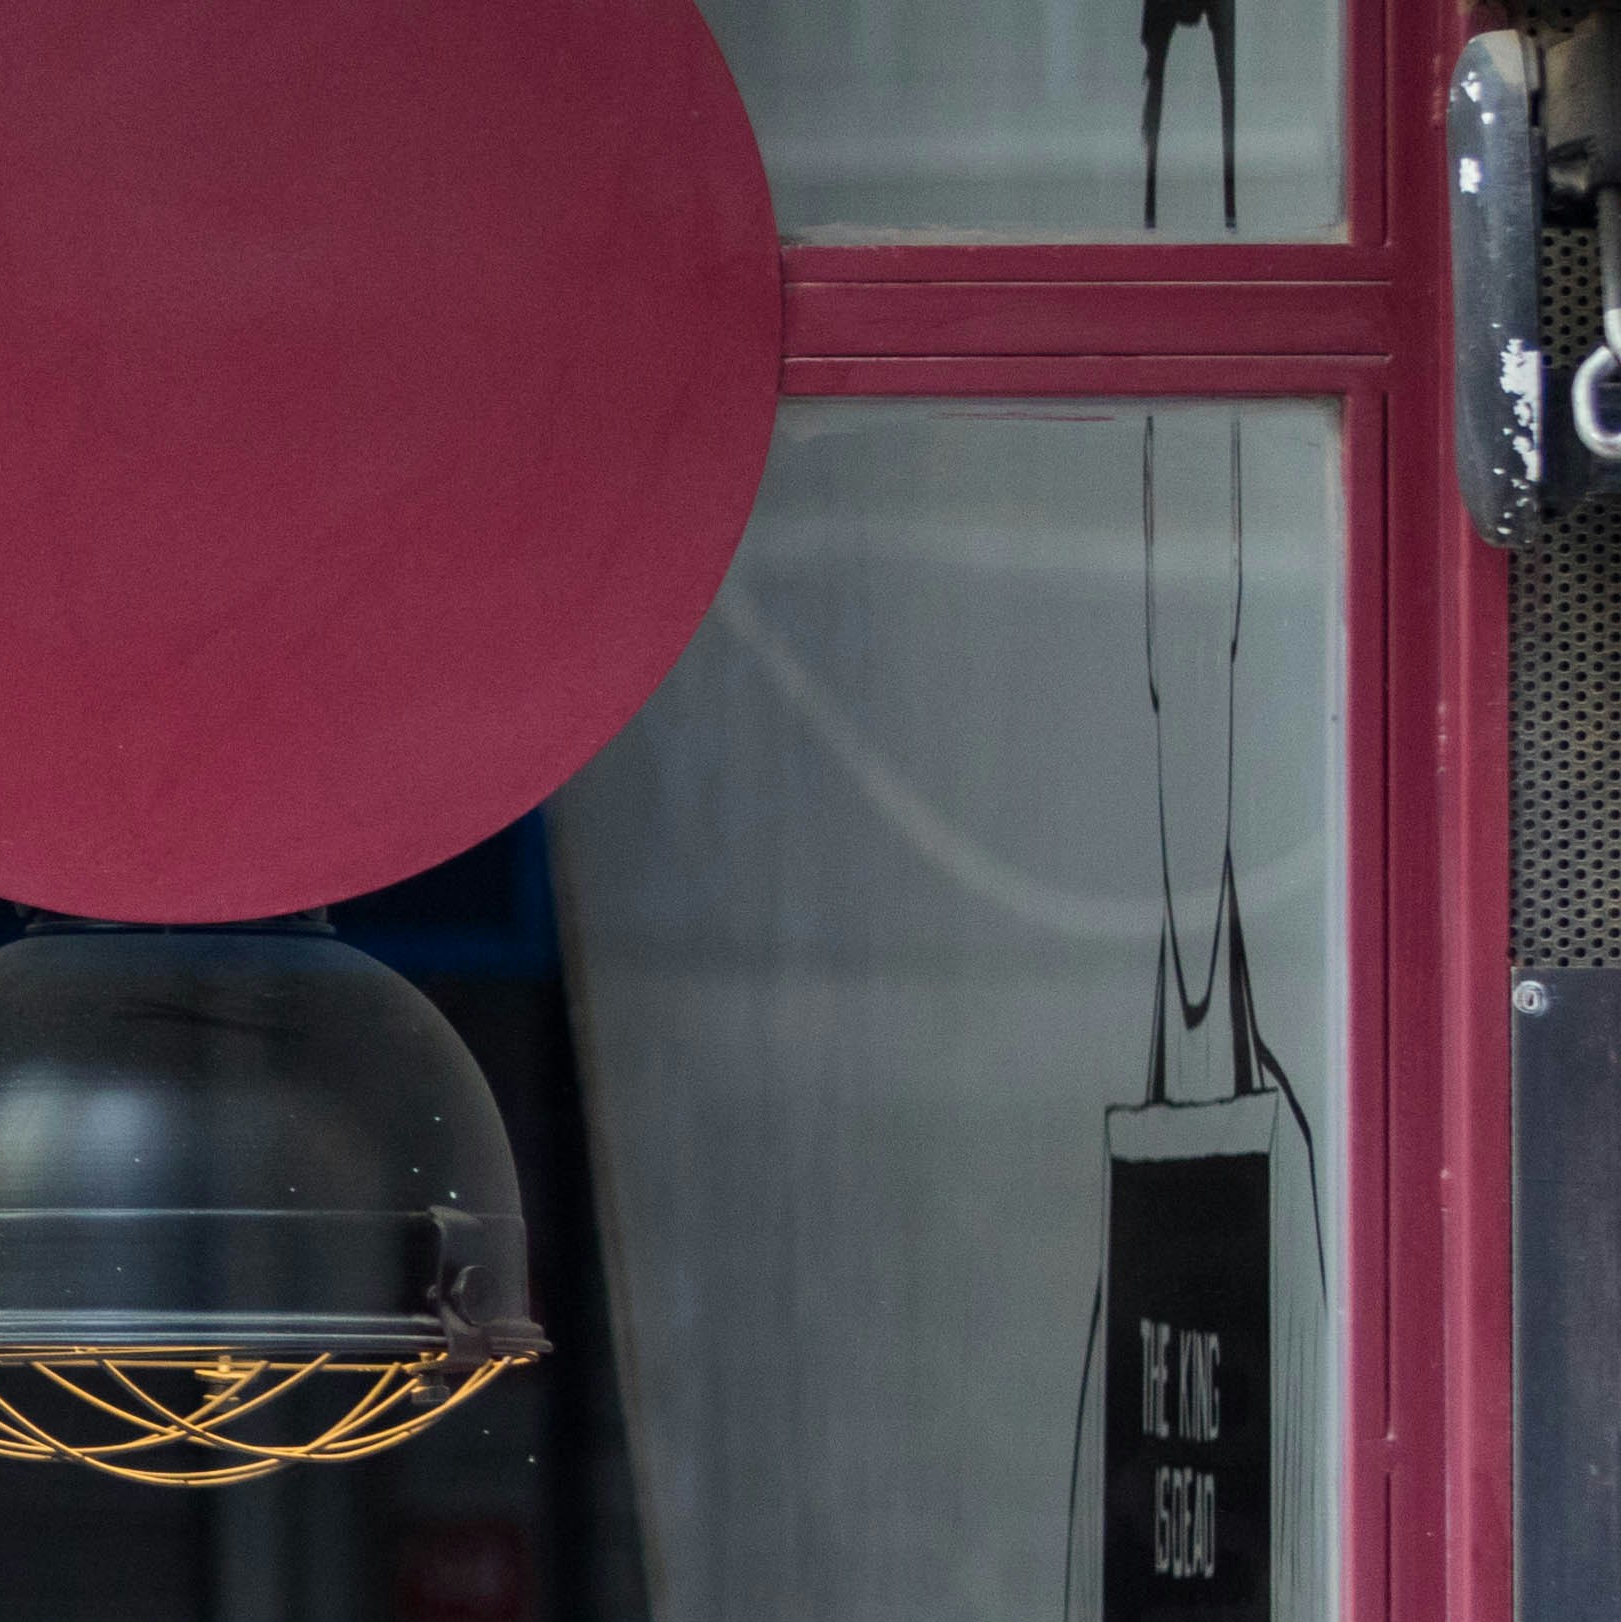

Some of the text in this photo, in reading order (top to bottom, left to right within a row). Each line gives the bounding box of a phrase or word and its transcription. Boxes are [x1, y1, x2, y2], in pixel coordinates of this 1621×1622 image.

[1140, 1317, 1220, 1442] THE KING
[1172, 1466, 1215, 1579] DEAD
